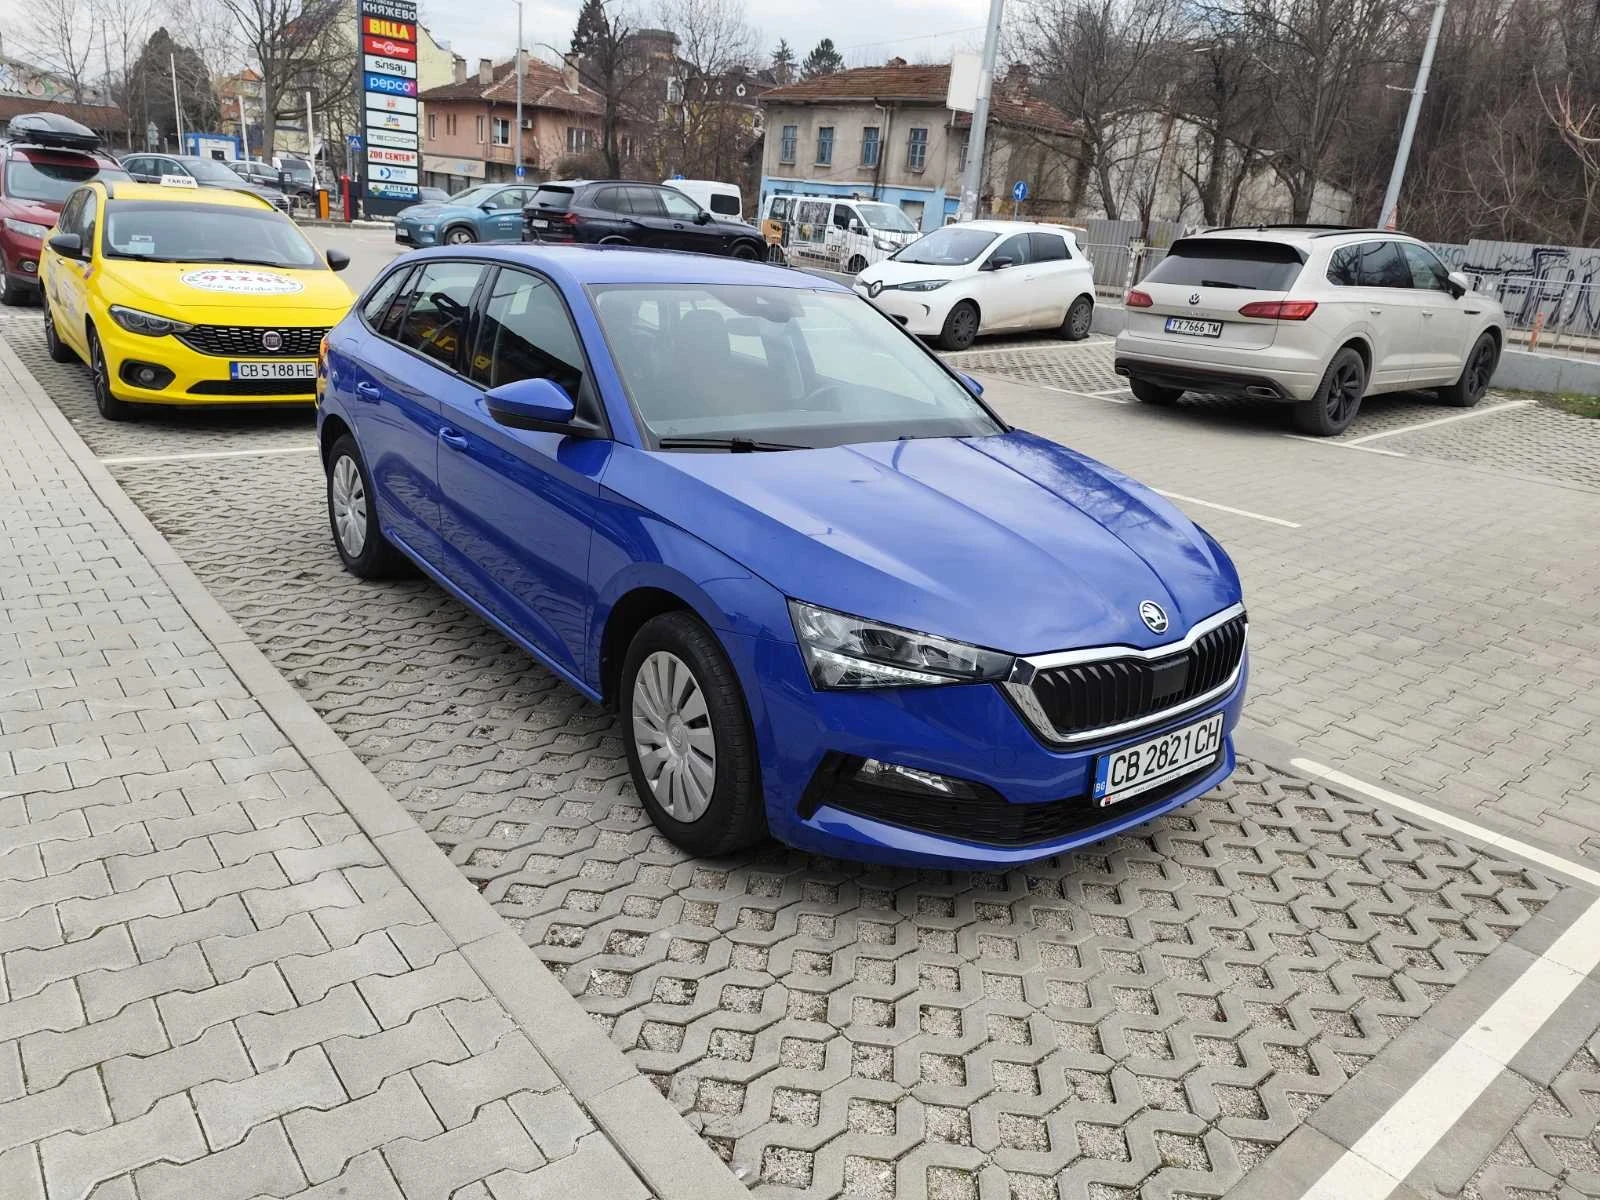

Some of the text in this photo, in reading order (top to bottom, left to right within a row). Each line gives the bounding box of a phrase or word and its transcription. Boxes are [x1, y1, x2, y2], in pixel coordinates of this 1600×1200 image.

[363, 2, 416, 21] КНЯЖЕВО
[370, 18, 409, 40] BILLA
[375, 59, 407, 75] sinsay
[370, 77, 410, 92] pepco
[369, 151, 410, 162] ZOO CENTER
[384, 184, 415, 193] АПТЕКА
[1173, 320, 1184, 330] TX
[1184, 320, 1205, 332] 7666
[1207, 323, 1220, 334] TM
[240, 364, 314, 377] CB 5188 HE
[1111, 750, 1141, 787] CB
[1143, 731, 1192, 776] 2821
[1194, 719, 1220, 754] CH
[1095, 781, 1106, 793] BG
